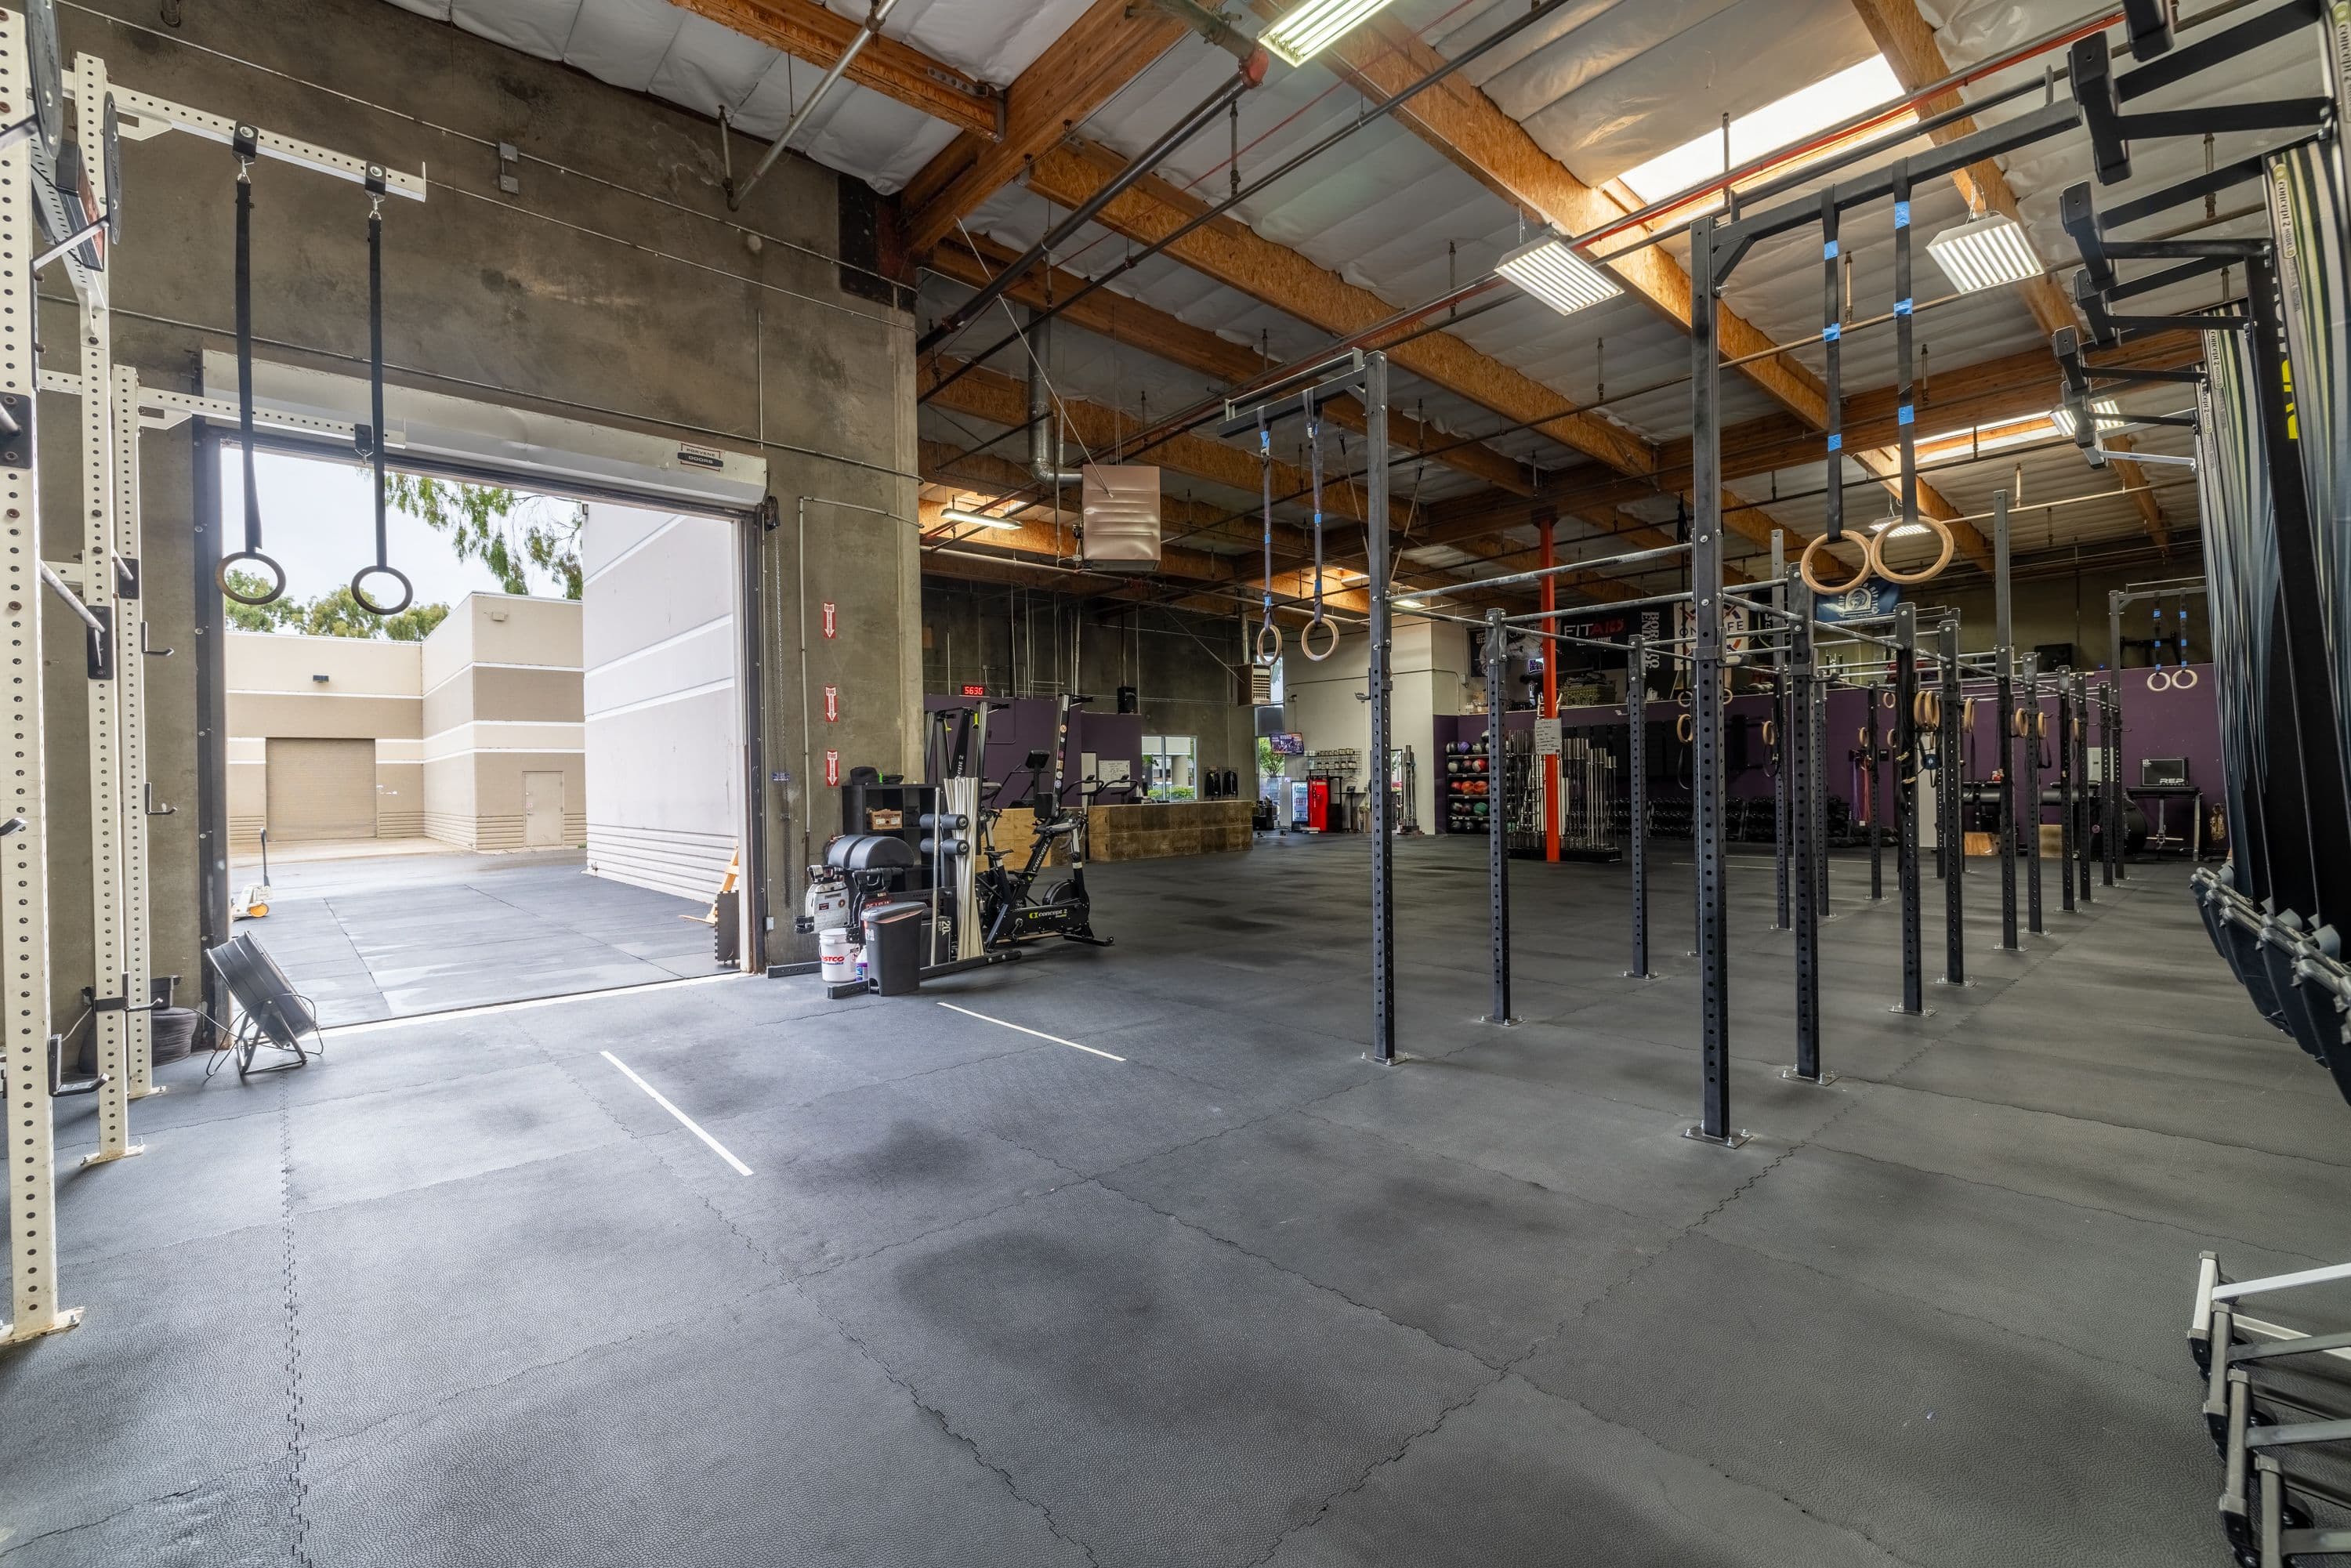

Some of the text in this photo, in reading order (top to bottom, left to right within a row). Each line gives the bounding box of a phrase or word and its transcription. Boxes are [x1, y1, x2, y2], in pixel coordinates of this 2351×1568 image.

[2277, 181, 2290, 220] concept
[2211, 331, 2220, 361] concept
[688, 455, 714, 465] DOORS
[941, 920, 951, 932] 20
